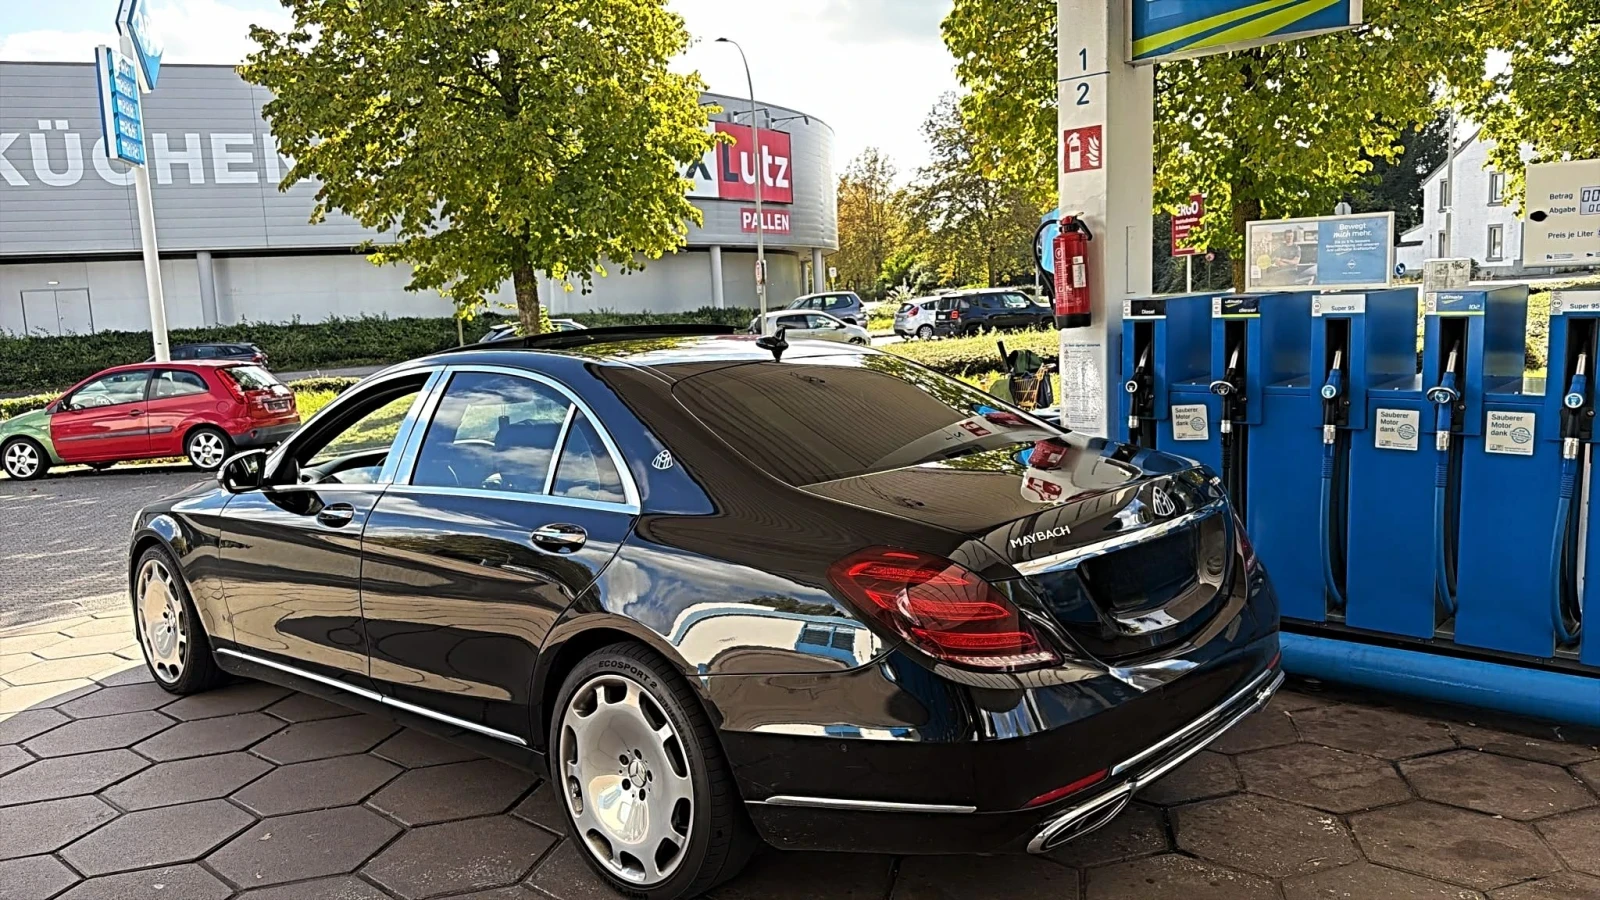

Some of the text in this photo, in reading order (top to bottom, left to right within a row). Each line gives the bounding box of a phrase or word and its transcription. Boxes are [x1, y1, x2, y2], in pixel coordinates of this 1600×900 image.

[1079, 48, 1087, 71] 1
[1076, 82, 1090, 106] 2
[1549, 206, 1576, 214] Abgabe
[743, 212, 790, 231] PALLEN
[1340, 223, 1367, 231] Bewegt
[1333, 229, 1372, 239] mich mehr.
[1380, 411, 1409, 419] Sauberer
[1010, 525, 1071, 549] MAYBACH
[598, 660, 658, 689] ECOSPORT 2
